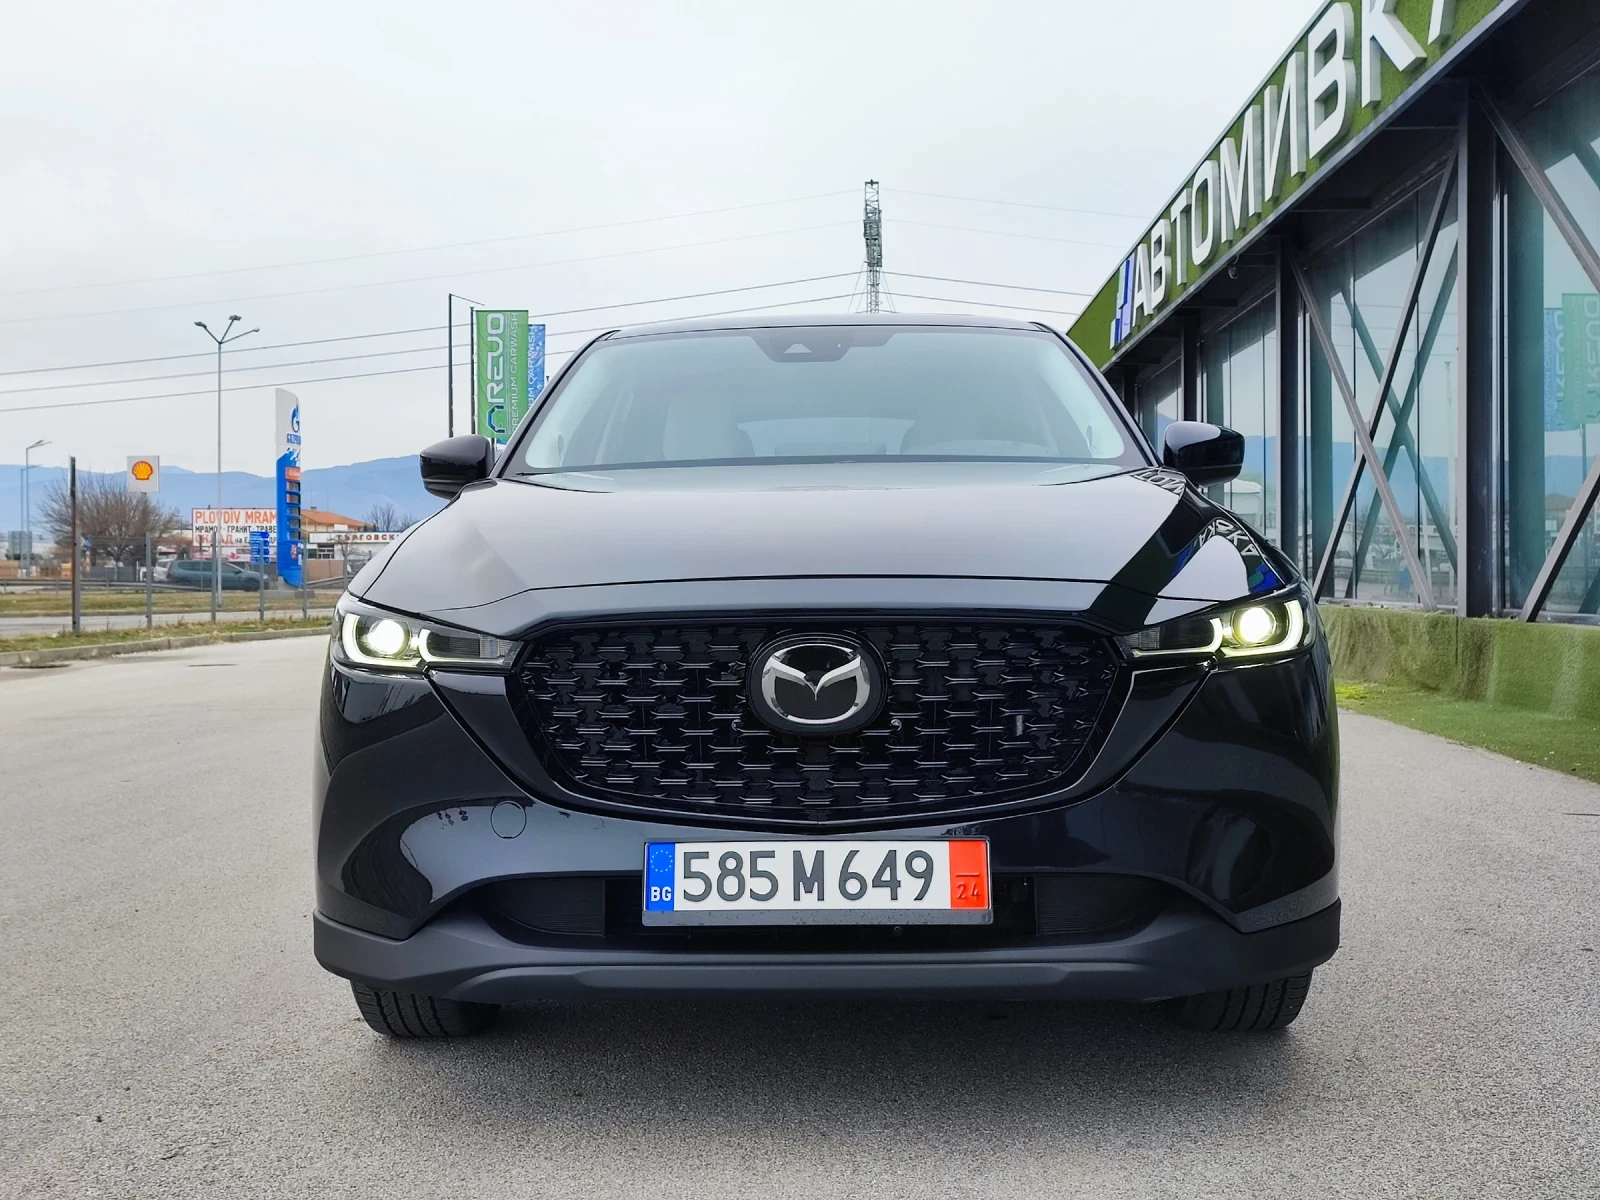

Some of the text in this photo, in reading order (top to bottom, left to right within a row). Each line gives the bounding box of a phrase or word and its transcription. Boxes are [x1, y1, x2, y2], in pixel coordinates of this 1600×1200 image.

[1131, 0, 1454, 328] АВТОМИВК
[509, 312, 518, 374] CARWASH
[195, 525, 222, 533] МРАМО
[227, 525, 251, 533] ГРАНИТ
[650, 886, 672, 902] BG
[683, 850, 780, 903] 585
[838, 850, 934, 902] 649
[956, 882, 981, 900] 24
